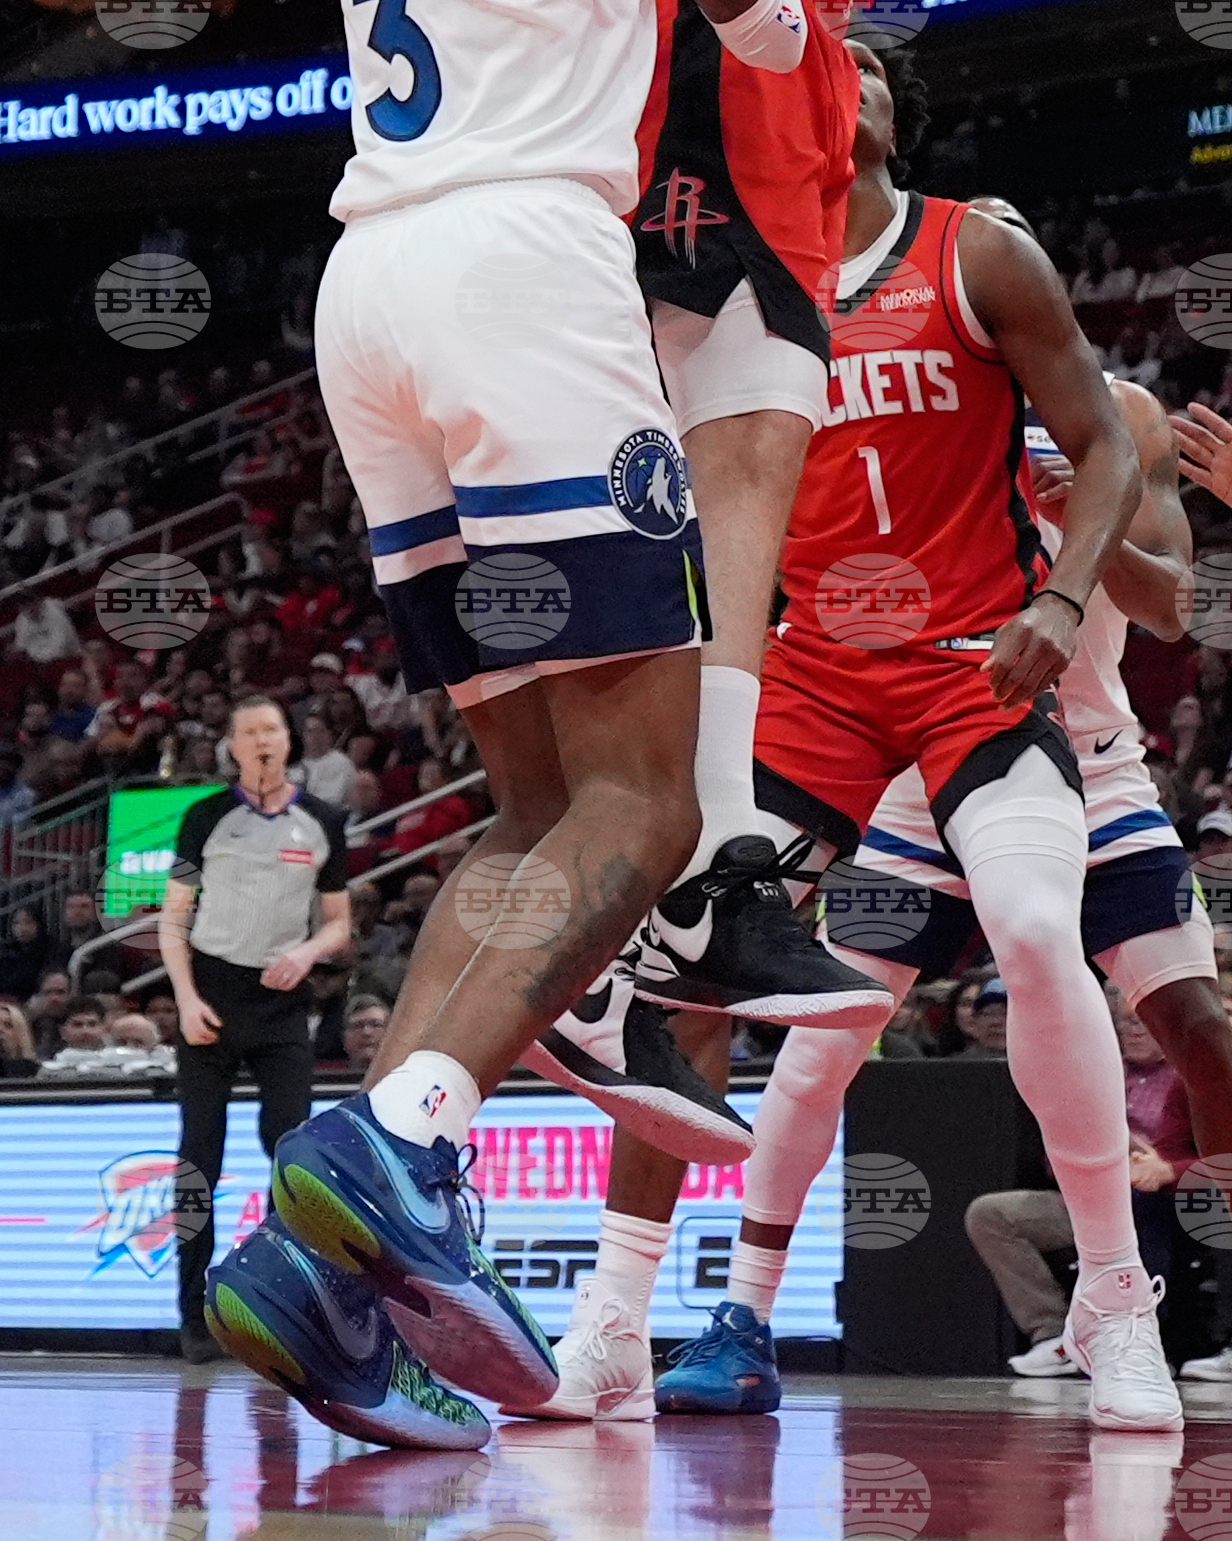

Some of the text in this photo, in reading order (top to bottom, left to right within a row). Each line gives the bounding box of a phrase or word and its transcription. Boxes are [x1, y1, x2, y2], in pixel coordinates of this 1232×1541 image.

[82, 84, 182, 135] work
[182, 84, 274, 136] pays
[275, 66, 330, 118] off
[612, 434, 643, 507] MINNESOTA
[857, 445, 892, 535] 1
